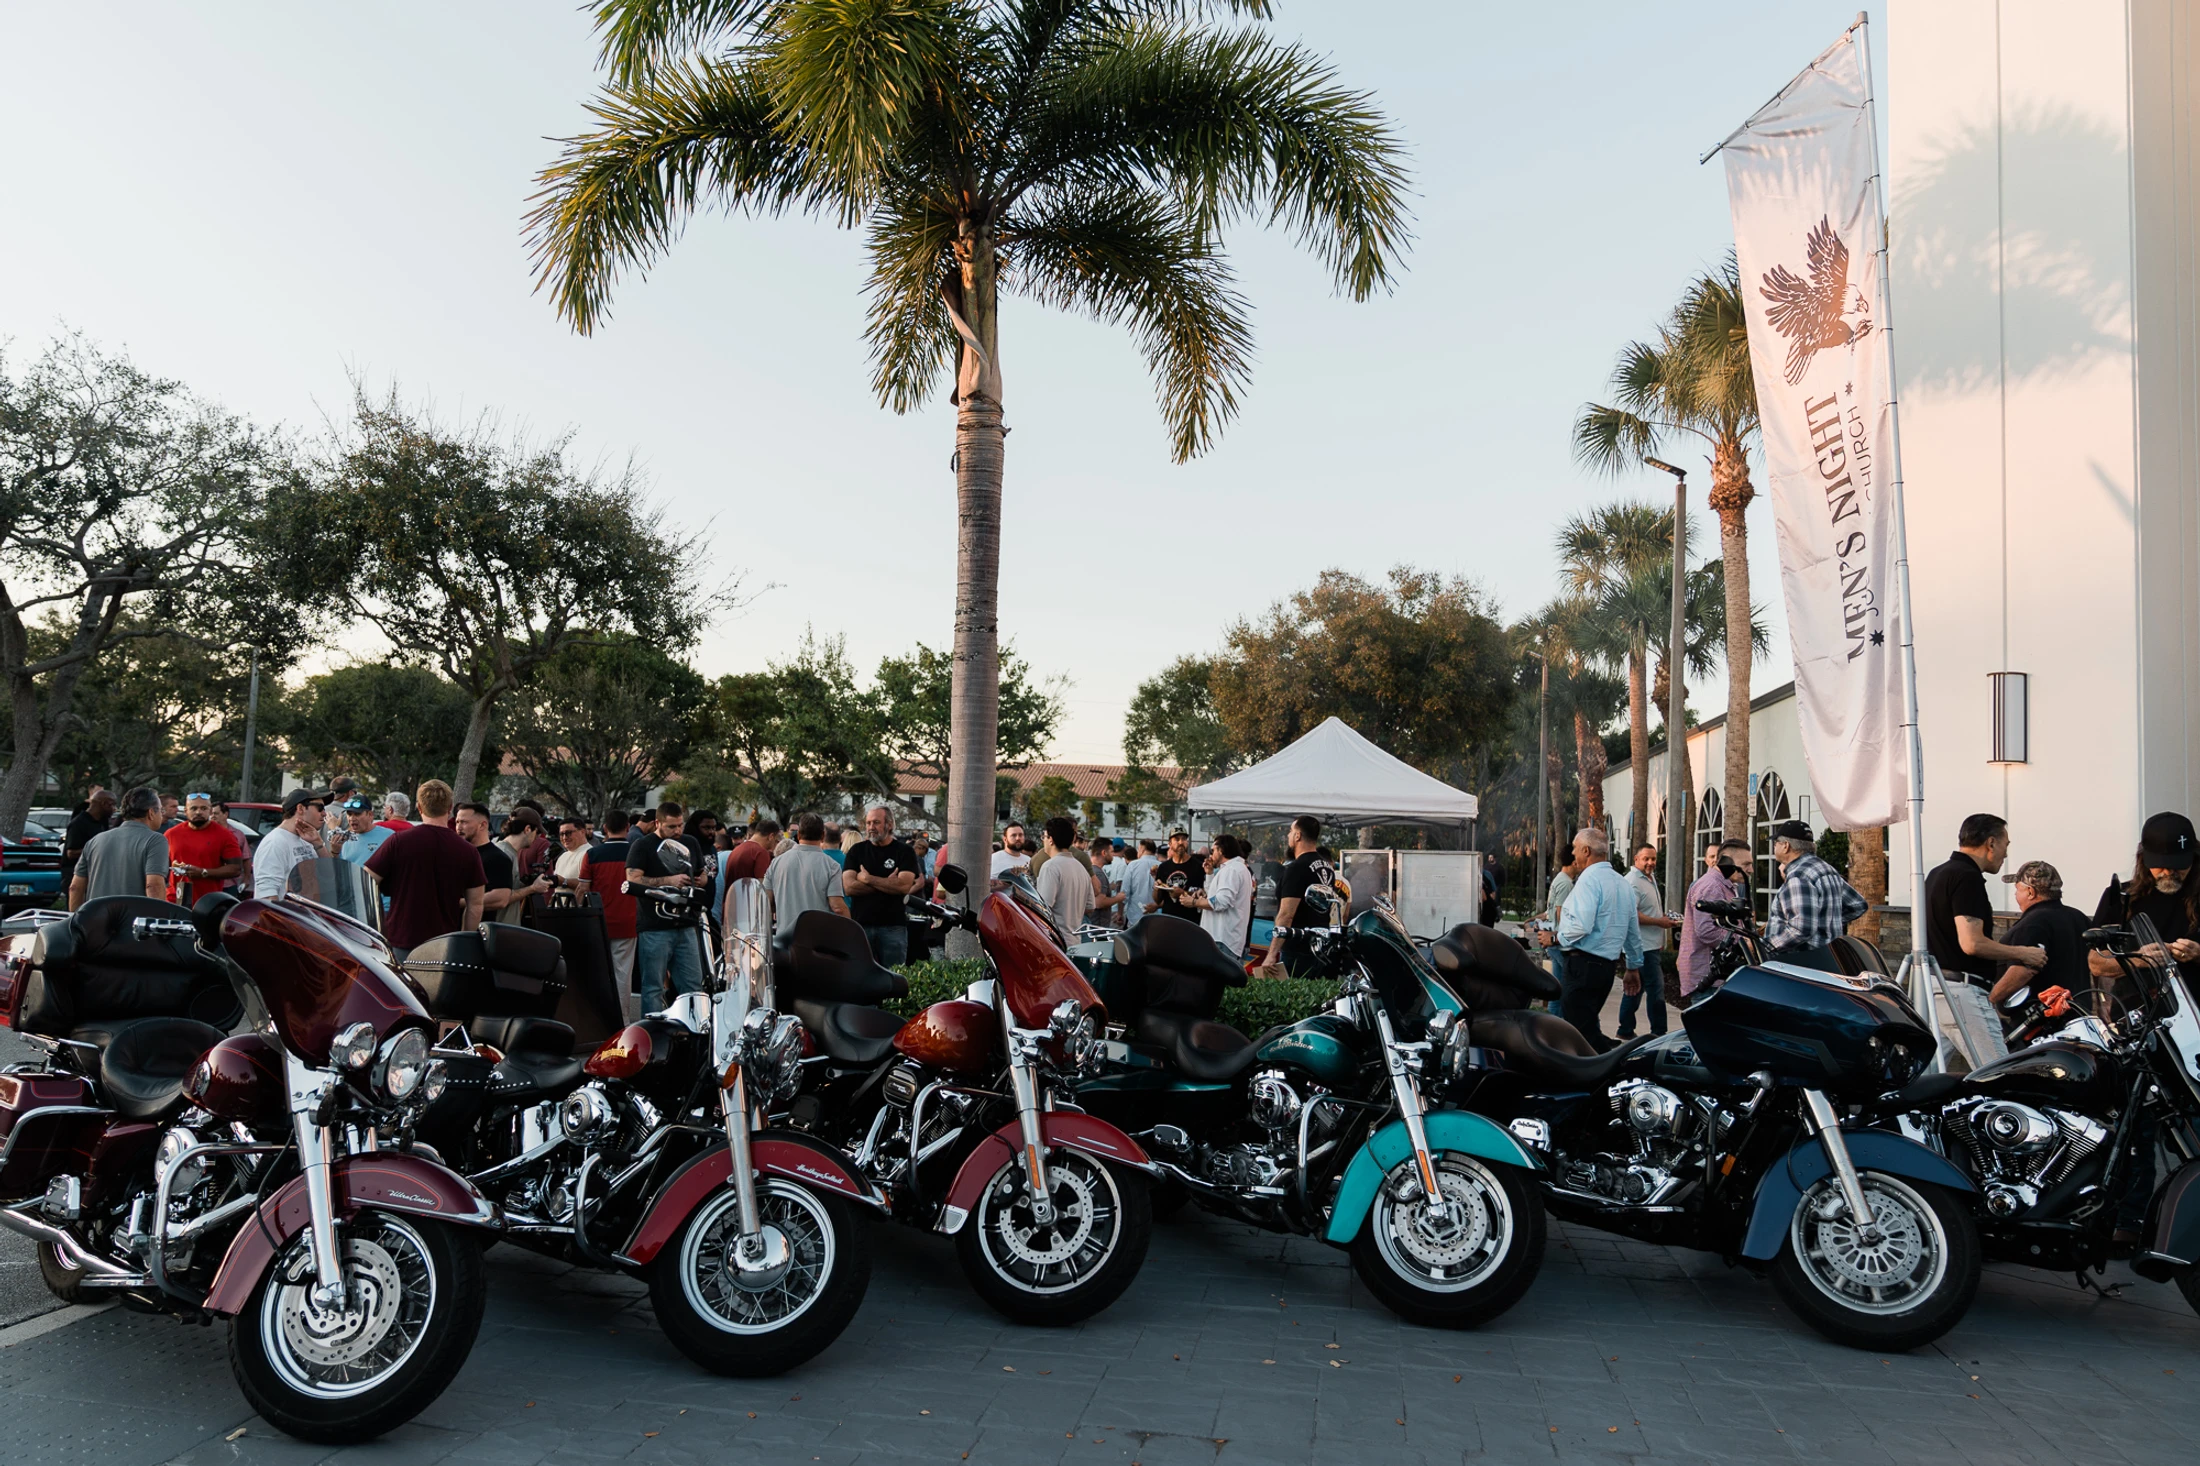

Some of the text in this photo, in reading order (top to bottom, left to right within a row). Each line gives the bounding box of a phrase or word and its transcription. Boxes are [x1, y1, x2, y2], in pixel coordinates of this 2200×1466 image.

[1804, 392, 1868, 663] MEN'S NIGHT
[1309, 859, 1324, 872] FREE
